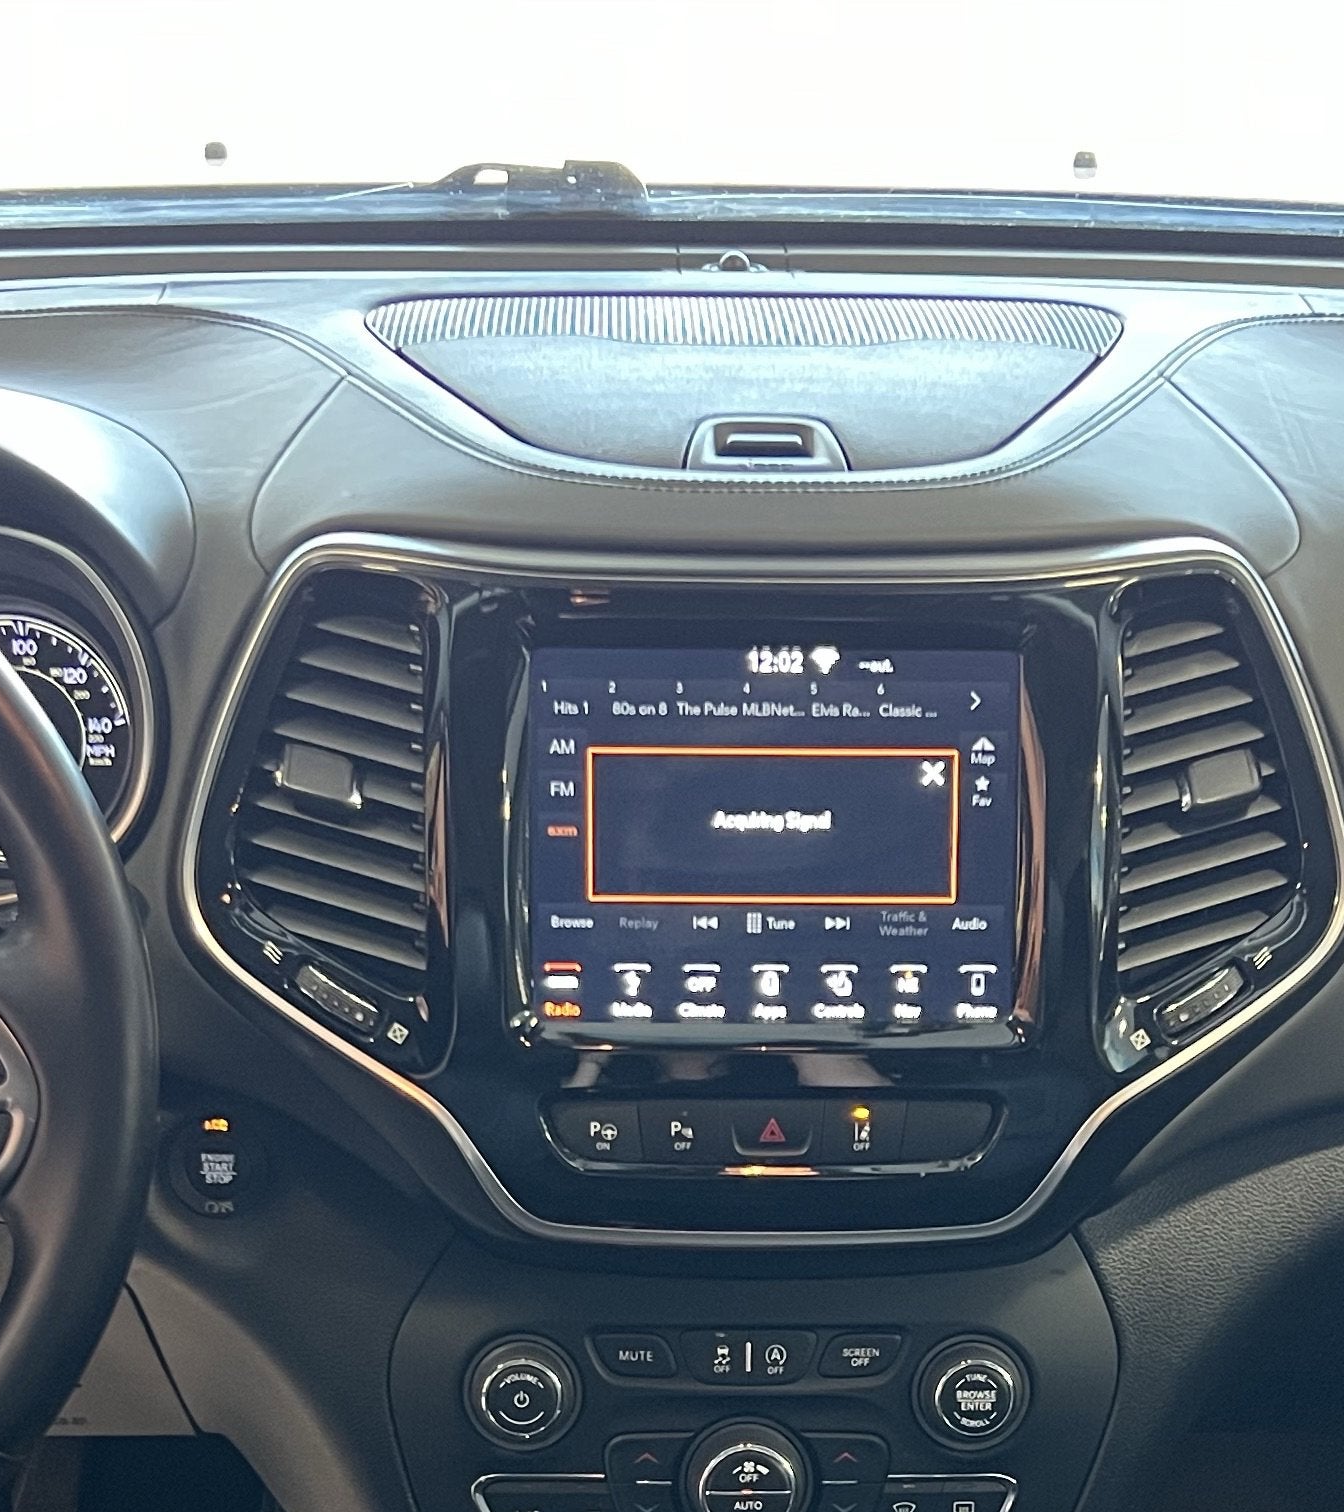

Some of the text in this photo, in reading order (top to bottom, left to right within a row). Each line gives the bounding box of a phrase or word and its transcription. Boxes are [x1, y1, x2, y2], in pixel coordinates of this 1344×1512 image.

[12, 638, 38, 656] 100
[748, 649, 805, 674] 12:02
[63, 667, 88, 684] 120
[541, 679, 548, 693] 1
[608, 680, 617, 694] 2
[675, 681, 684, 694] 3
[742, 681, 751, 694] 4
[810, 682, 818, 695] 5
[877, 683, 885, 695] 6
[553, 700, 590, 716] Hits 1
[639, 705, 656, 716] on
[676, 701, 738, 717] The Pulse
[878, 704, 923, 718] Classic
[549, 737, 575, 755] AM
[970, 752, 996, 767] Map
[549, 781, 575, 797] FM
[972, 794, 993, 807] Fav
[712, 810, 833, 833] Acquiring Signal
[550, 915, 595, 929] Browse
[766, 916, 796, 930] Tune
[881, 911, 928, 923] Traffic &
[619, 916, 660, 931] Replay
[952, 917, 988, 931] Audio
[879, 925, 929, 937] Weather
[543, 1001, 582, 1018] Radio
[595, 1142, 611, 1151] ON
[674, 1142, 692, 1151] OFF
[853, 1142, 871, 1152] OFF
[202, 1162, 234, 1172] START
[205, 1173, 233, 1184] STOP
[618, 1350, 654, 1362] MUTE
[842, 1347, 880, 1357] SCREEN
[850, 1357, 870, 1367] OFF
[713, 1365, 731, 1373] OFF
[767, 1365, 785, 1375] OFF
[504, 1373, 540, 1385] VOLUME
[965, 1374, 988, 1382] TUNE
[956, 1390, 997, 1400] BROWSE
[960, 1402, 992, 1411] ENTER
[960, 1417, 991, 1427] SCROLL
[739, 1474, 759, 1484] OFF
[733, 1501, 763, 1511] AUTO
